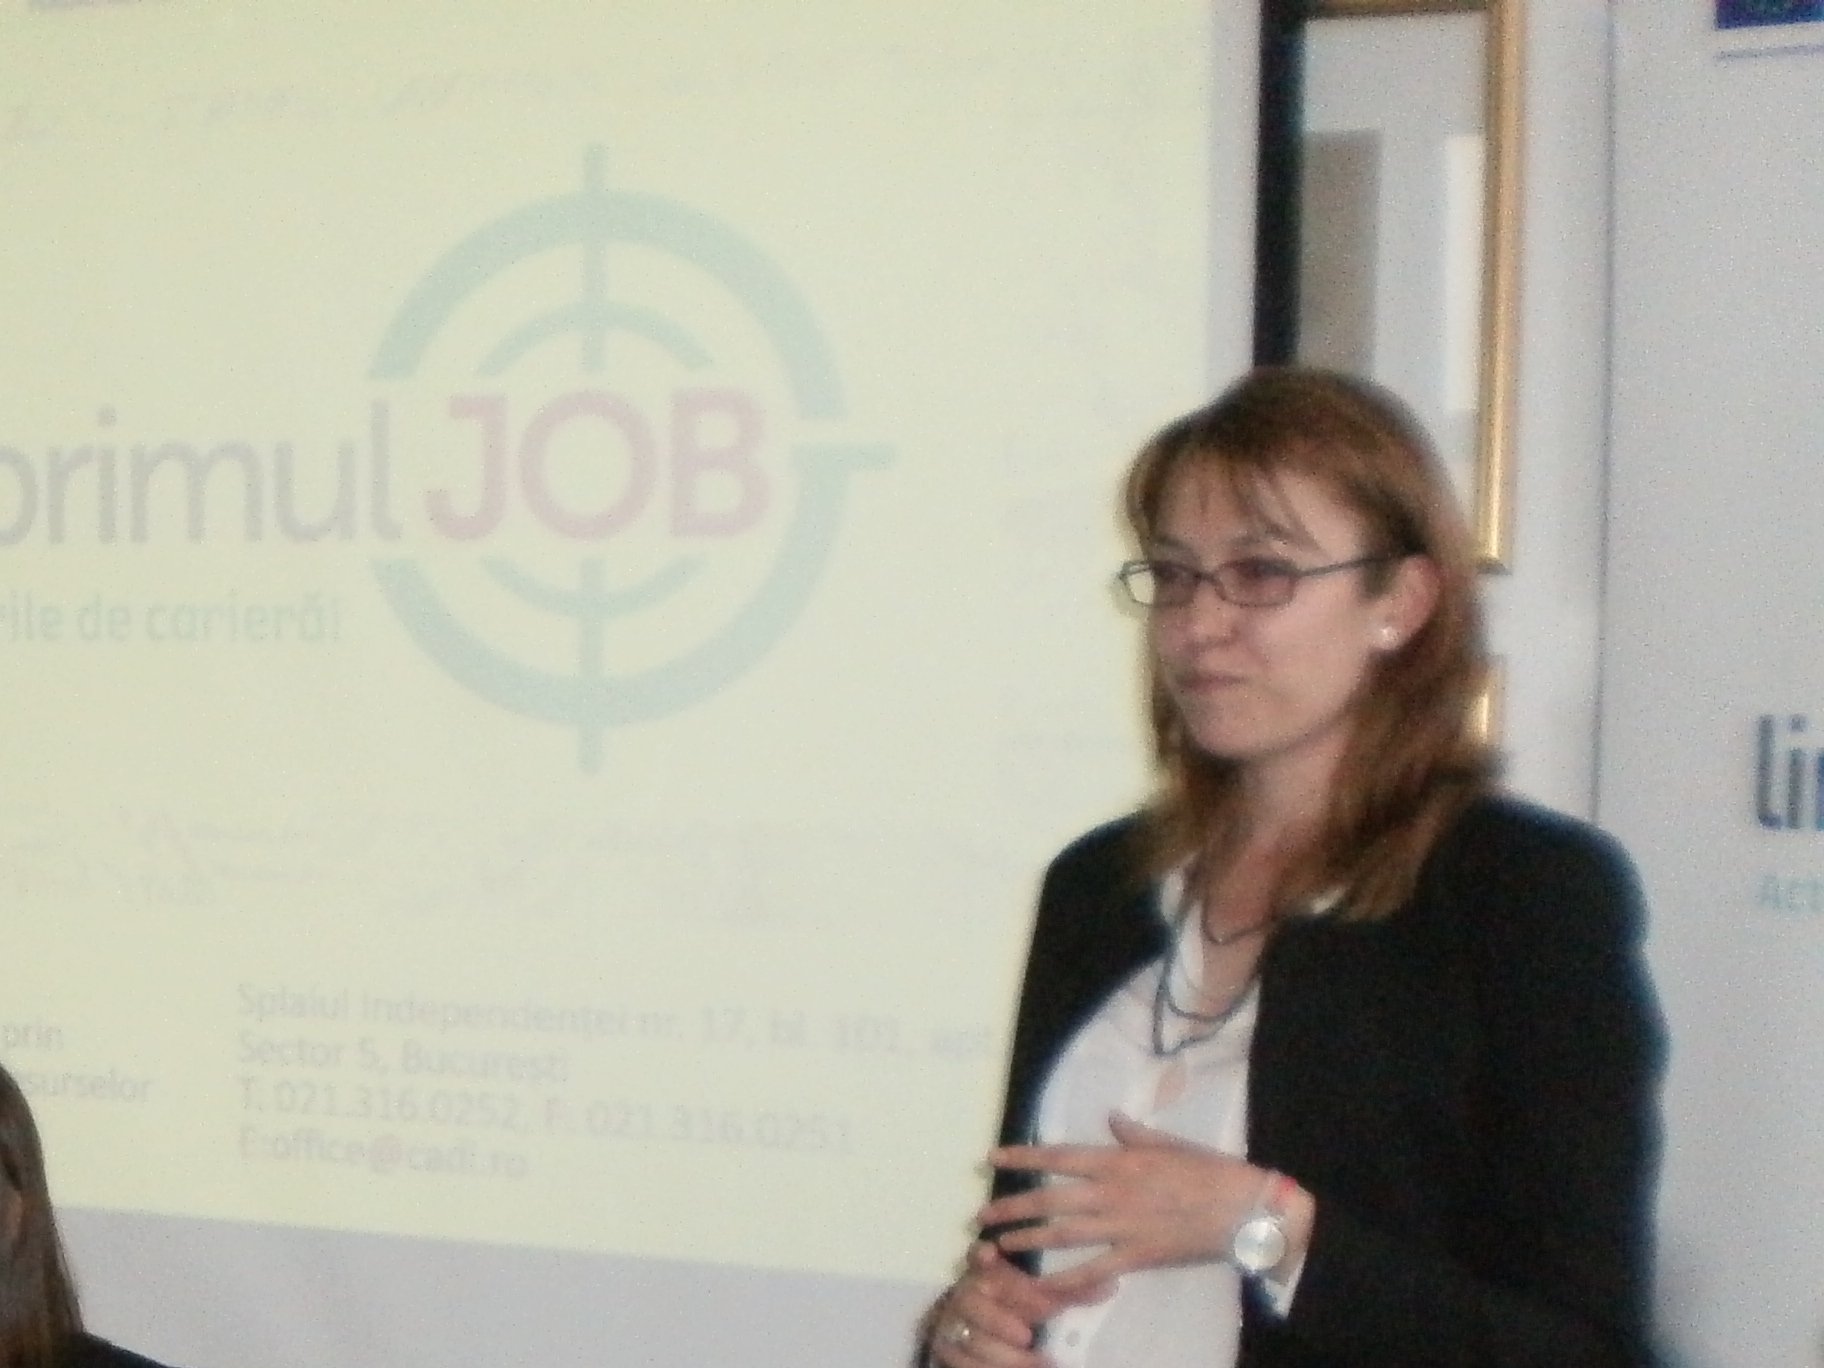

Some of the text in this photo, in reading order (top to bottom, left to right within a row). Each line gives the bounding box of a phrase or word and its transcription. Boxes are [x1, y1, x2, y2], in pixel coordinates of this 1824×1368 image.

[424, 386, 778, 545] JOB
[76, 590, 130, 645] de
[236, 980, 349, 1023] Splaiul
[636, 1009, 685, 1041] nr.
[701, 1005, 757, 1052] 17,
[236, 1028, 346, 1068] Sector
[356, 1035, 390, 1077] 5,
